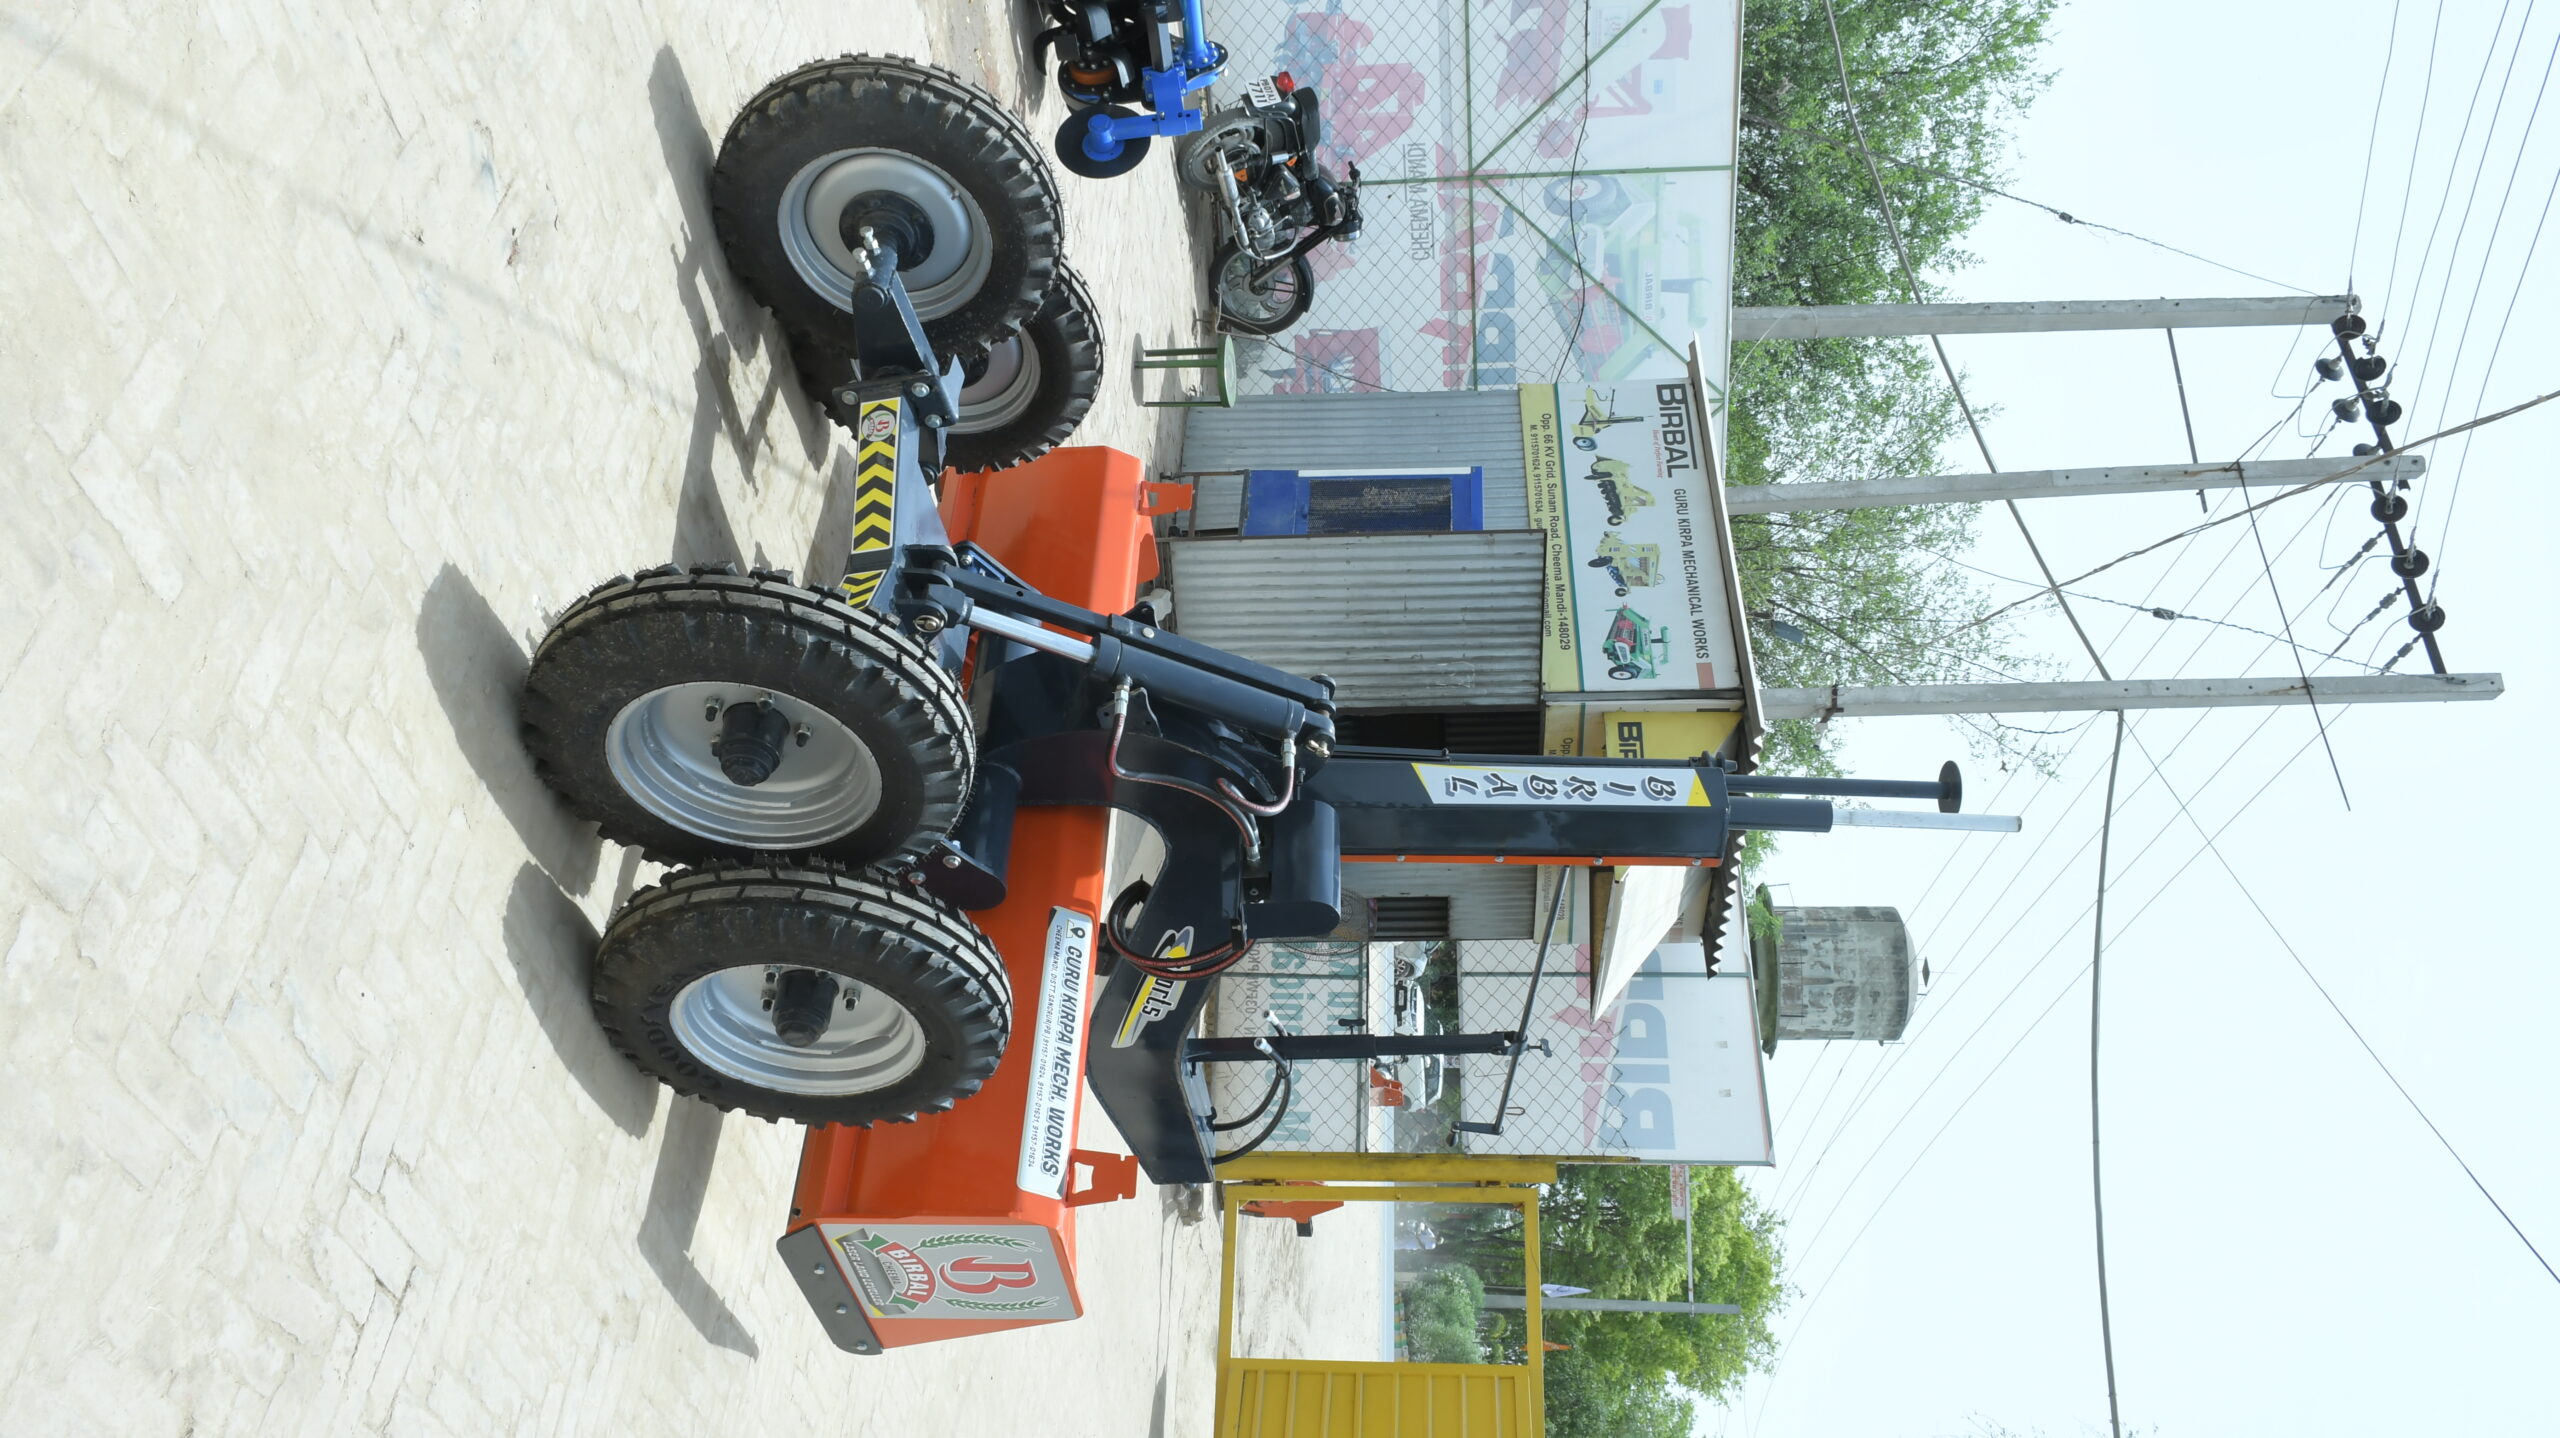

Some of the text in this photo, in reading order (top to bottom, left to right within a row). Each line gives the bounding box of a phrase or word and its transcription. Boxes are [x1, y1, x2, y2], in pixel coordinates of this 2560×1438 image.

[1248, 82, 1268, 103] 7711
[1656, 383, 1698, 479] BIRBAL
[1540, 413, 1571, 651] Opp. 66 KV Grid, Sunam Road, Cheema Mandi-148029
[1673, 488, 1710, 659] GURU KIRPA MECHANICAL WORKS
[1054, 925, 1063, 950] CHEEMA
[1041, 945, 1083, 1178] GURU KIRPA MECH. WORKS
[842, 1241, 884, 1307] LASER LAND LEVELLER
[881, 1261, 901, 1286] CHEEMA
[887, 1250, 930, 1296] BIRBAL
